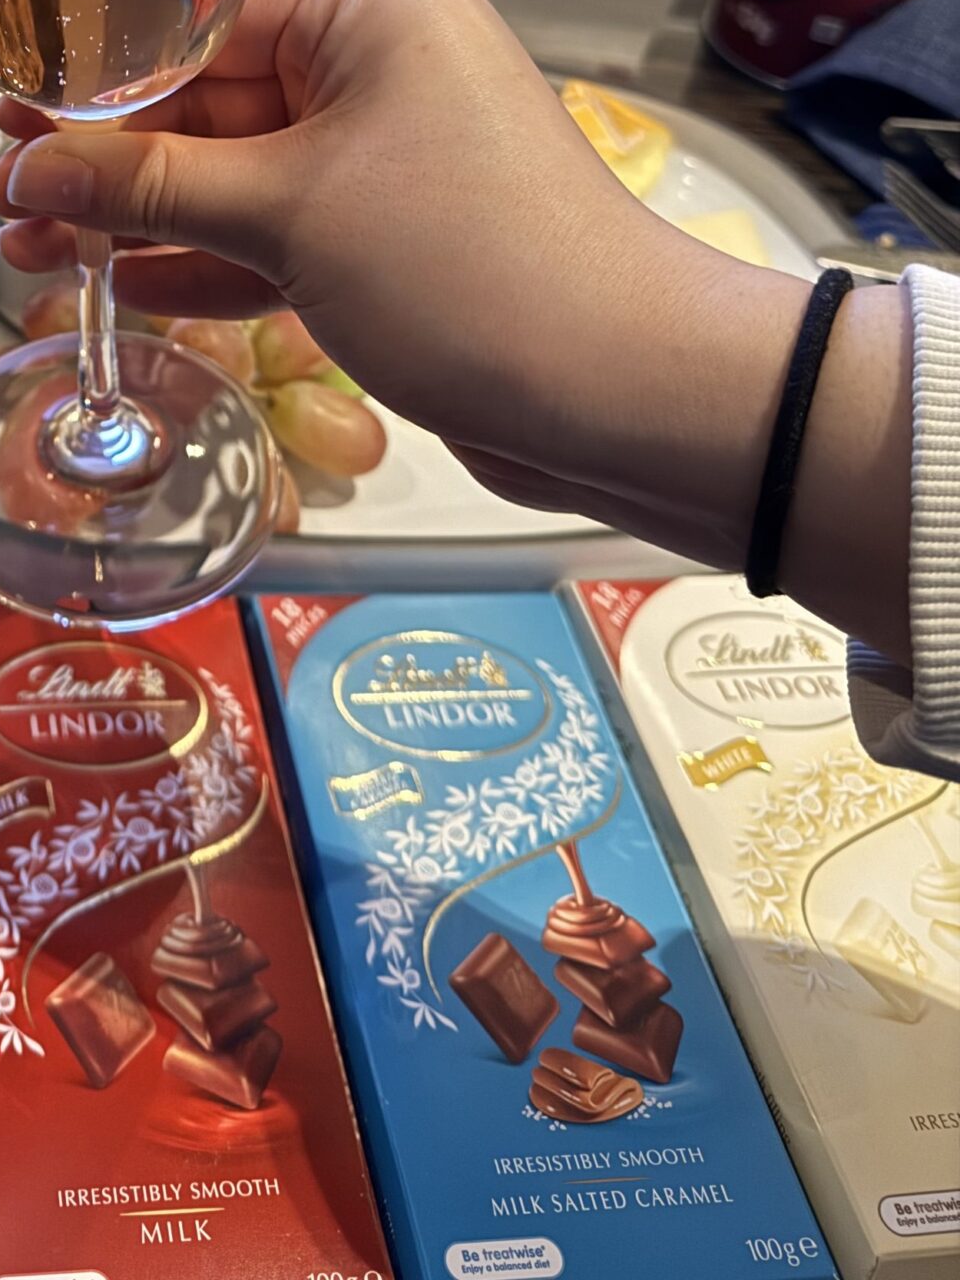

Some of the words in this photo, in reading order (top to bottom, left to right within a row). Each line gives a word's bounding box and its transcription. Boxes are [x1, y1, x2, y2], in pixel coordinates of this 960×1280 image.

[271, 597, 302, 628] 18
[696, 632, 792, 667] Lindt
[18, 665, 136, 701] Lindt
[716, 676, 842, 703] LINDOR
[30, 711, 166, 739] LINDOR
[383, 701, 518, 728] LINDOR
[701, 746, 752, 780] WHITE
[909, 1112, 960, 1131] IRRES
[494, 1152, 611, 1175] IRRESISTIBLY
[618, 1147, 705, 1167] SMOOTH
[57, 1183, 182, 1207] IRRESISTIBLY
[190, 1178, 280, 1200] SMOOTH
[491, 1195, 544, 1217] MILK
[551, 1190, 627, 1213] SALTED
[635, 1184, 734, 1208] CARAMEL
[894, 1203, 913, 1215] Be
[141, 1220, 211, 1244] MILK
[461, 1250, 480, 1262] Be
[745, 1238, 800, 1266] 100g
[461, 1265, 484, 1275] Enjoy
[494, 1261, 532, 1272] balanced
[534, 1260, 550, 1269] diet
